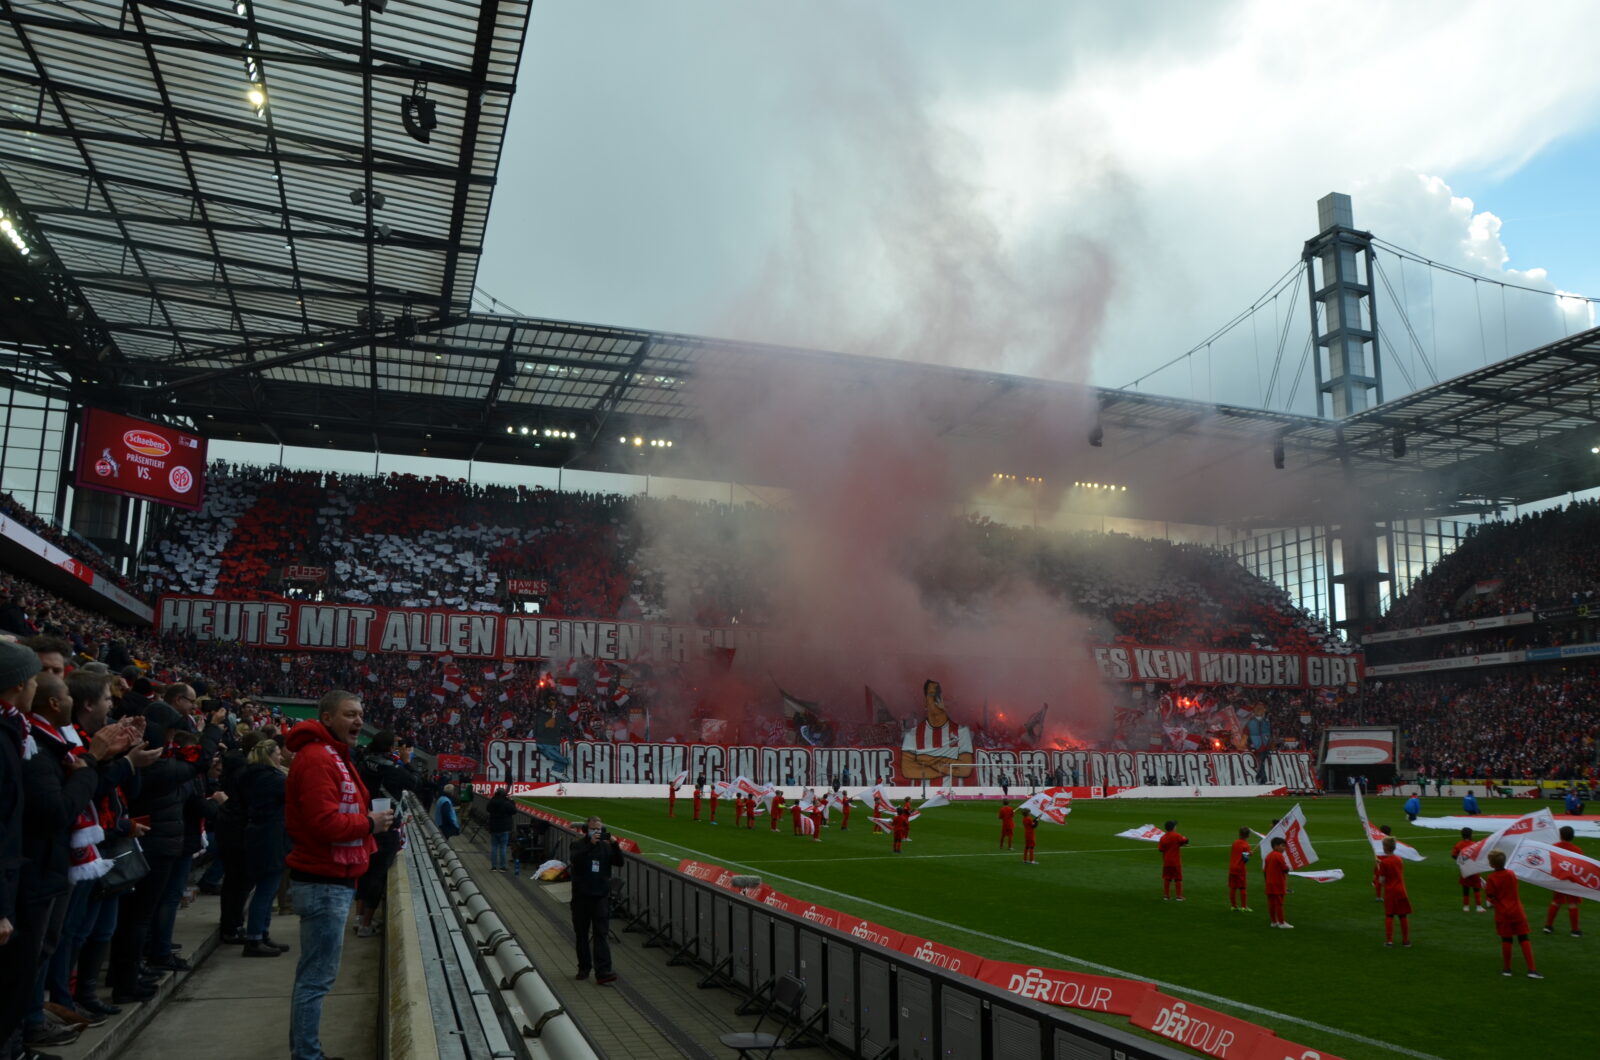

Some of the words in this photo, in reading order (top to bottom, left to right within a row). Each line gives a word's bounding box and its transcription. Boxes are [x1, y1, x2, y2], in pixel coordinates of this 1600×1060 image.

[128, 432, 165, 449] Schaebens
[126, 453, 165, 468] PRÄSENTIERT
[137, 466, 152, 480] VS.
[508, 580, 548, 593] HAWKS
[161, 598, 290, 645] HEUTE
[298, 605, 375, 648] MIT
[380, 611, 496, 656] ALLEN
[504, 617, 643, 661] MEINEN
[1093, 647, 1131, 679] ES
[1134, 648, 1193, 682] KEIN
[1198, 651, 1302, 686] MORGEN
[1307, 655, 1360, 688] GIBT
[563, 742, 615, 784] ICH
[618, 743, 688, 784] BEIM
[691, 746, 726, 785] FC
[727, 746, 758, 786] IN
[761, 747, 812, 786] DER
[813, 748, 895, 787] KURVE
[976, 750, 1018, 787] DER
[1052, 751, 1089, 787] IST
[1091, 752, 1135, 787] DAS
[1135, 752, 1212, 787] EINZIGE
[1212, 752, 1257, 787] WAS
[1008, 968, 1113, 1010] DERTOUR
[1152, 1002, 1234, 1058] DERTOUR
